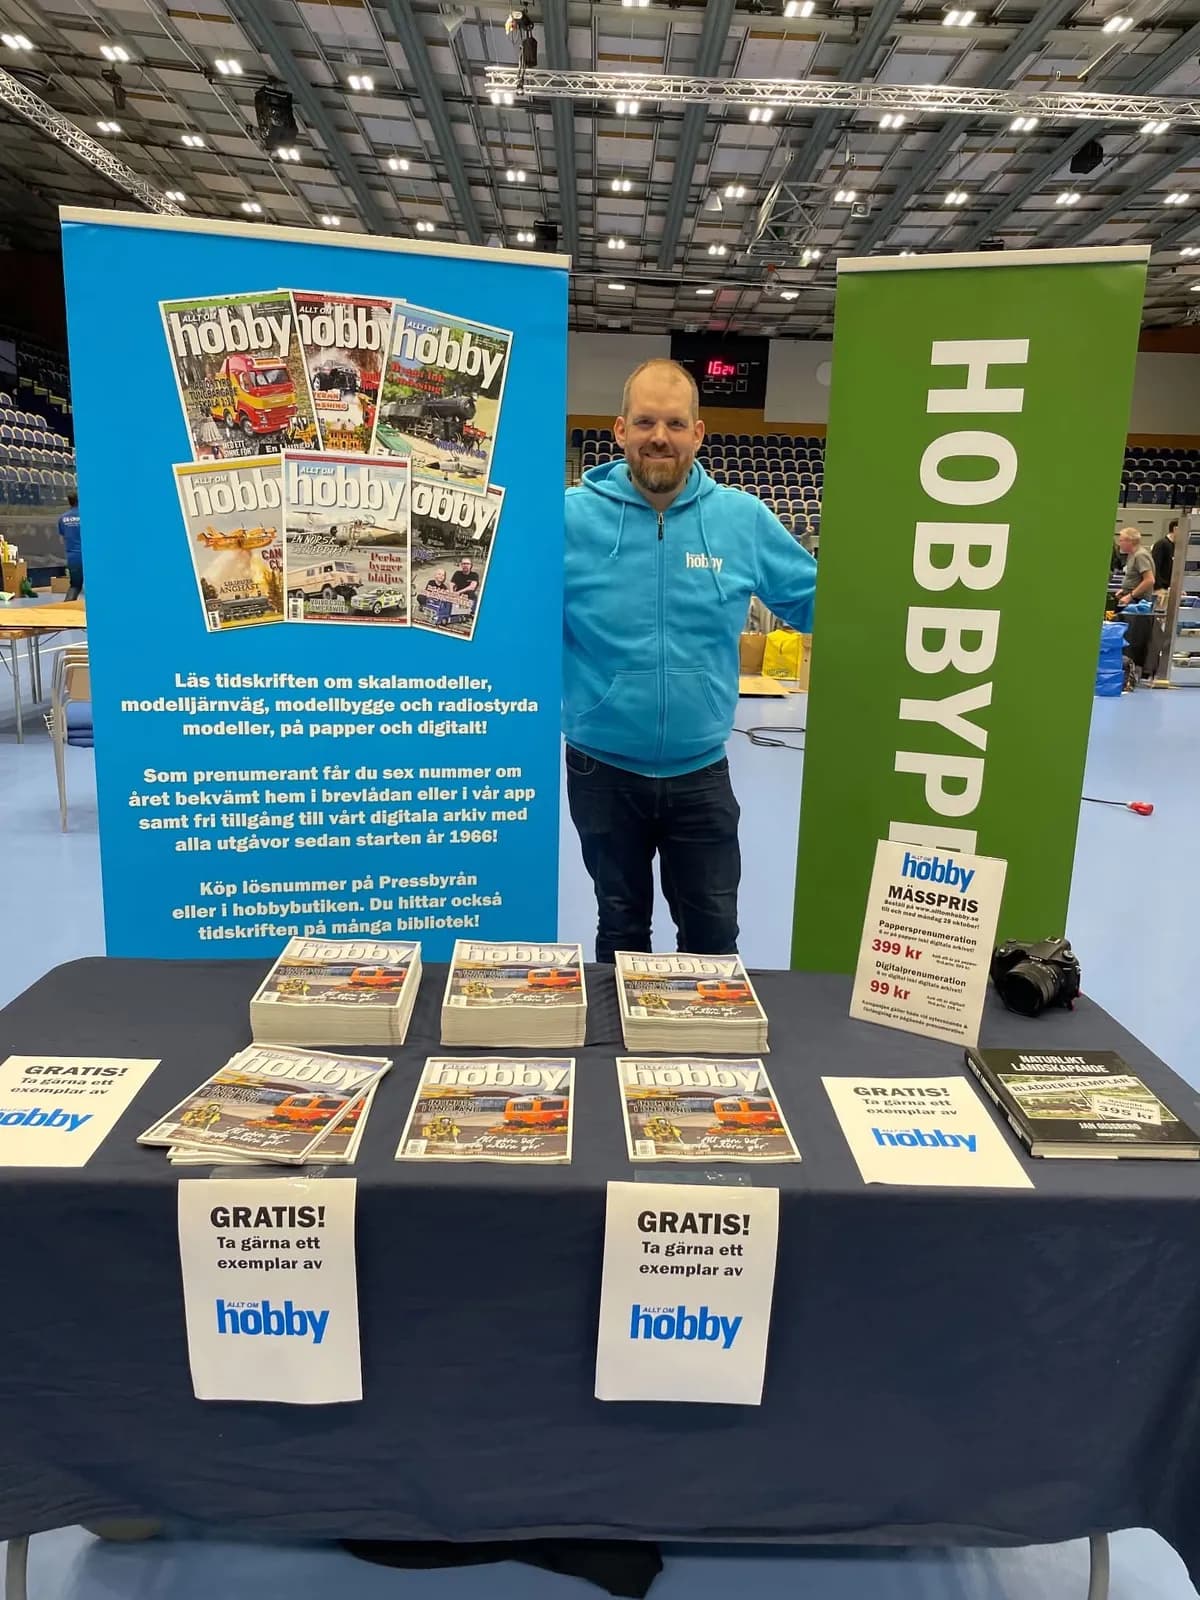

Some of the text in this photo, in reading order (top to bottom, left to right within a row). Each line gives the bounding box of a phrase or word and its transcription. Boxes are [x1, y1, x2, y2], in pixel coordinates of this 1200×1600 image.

[170, 306, 291, 357] hobby
[391, 315, 504, 389] hobby
[183, 468, 281, 517] hobb
[289, 462, 406, 521] hobby
[412, 485, 497, 540] obby
[175, 672, 492, 693] Läs tidskriften om skalamodeller,
[121, 696, 538, 716] modelljärnväg, modellbygge och radiostyrda
[182, 719, 488, 738] modeller, på papper och digitalt!
[143, 764, 522, 785] Som prenumerant får du sex nummer om
[128, 784, 536, 807] året bekvämt hem i brevlådan eller i vår app
[139, 807, 528, 830] samt fri tillgång till vårt digitala arkiv med
[175, 829, 498, 853] alla utgåvor sedan starten år 1966!
[200, 871, 478, 898] Köp lösnummer på Pressbyrån
[901, 852, 975, 893] hobby
[172, 891, 502, 920] eller i hobbybutiken. Du hittar också
[888, 884, 979, 914] MÄSSPRIS
[198, 914, 480, 941] tidskriften på många bibliotek!
[879, 919, 977, 947] Pappersprenumeration
[871, 938, 923, 961] 399 kr
[875, 960, 967, 987] Digitalprenumeration
[870, 980, 911, 1000] 99 kr
[24, 1065, 129, 1077] GRATIS!
[428, 1062, 570, 1091] hobby
[626, 1062, 761, 1092] hobby
[10, 1087, 87, 1095] exemplar
[853, 1086, 951, 1097] GRATIS!
[866, 1108, 935, 1116] exemplar
[871, 1127, 977, 1152] hobby
[210, 1206, 326, 1228] GRATIS!
[637, 1210, 751, 1236] GRATIS!
[216, 1236, 321, 1251] Ta gärna ett
[641, 1241, 744, 1257] Ta gärna ett
[217, 1257, 323, 1272] exemplar av
[639, 1263, 744, 1277] exemplar av
[216, 1298, 330, 1344] hobby
[629, 1304, 744, 1349] hobby
